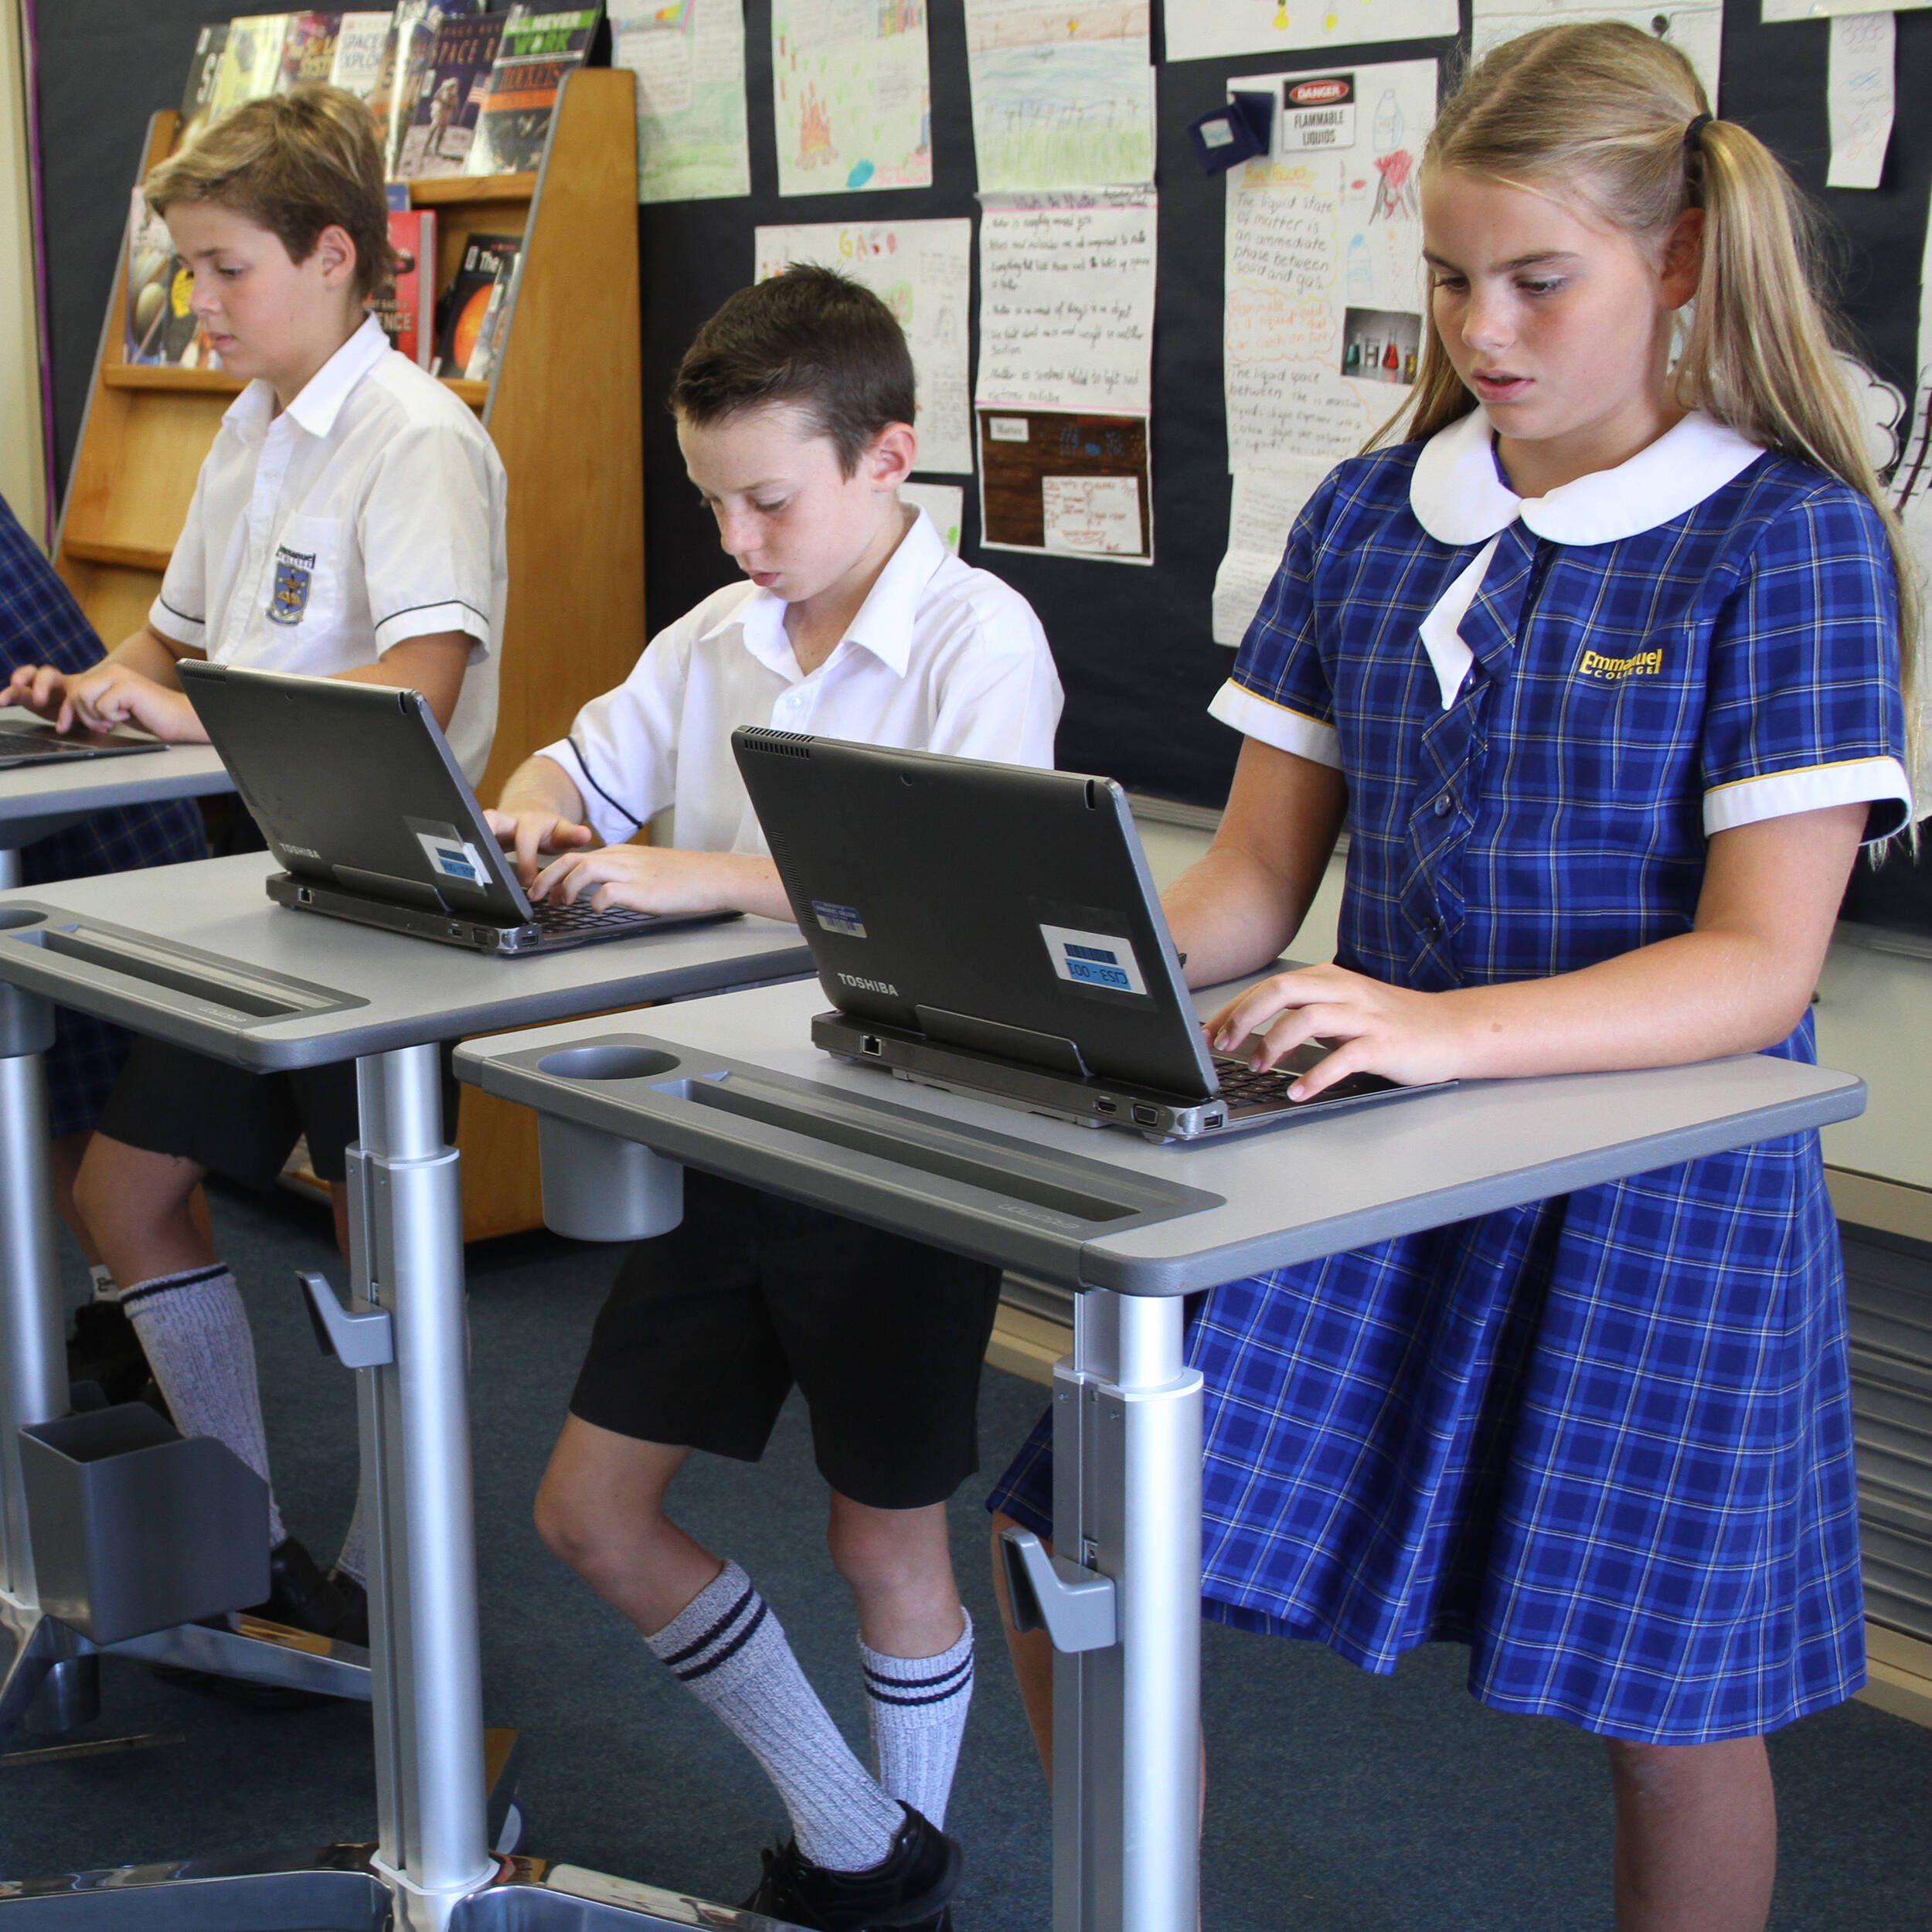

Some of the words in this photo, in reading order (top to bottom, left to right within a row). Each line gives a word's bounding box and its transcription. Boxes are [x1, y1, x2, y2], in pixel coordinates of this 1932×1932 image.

[532, 11, 581, 31] NEVER
[1298, 86, 1341, 100] DANGER
[1294, 111, 1344, 128] FLAMMABLE
[1303, 129, 1336, 146] LIQUIDS
[1274, 251, 1329, 272] between
[1230, 383, 1282, 399] between
[1579, 649, 1663, 675] Emmanuel
[279, 842, 321, 859] TOSHIBA
[837, 973, 900, 996] TOSHIBA
